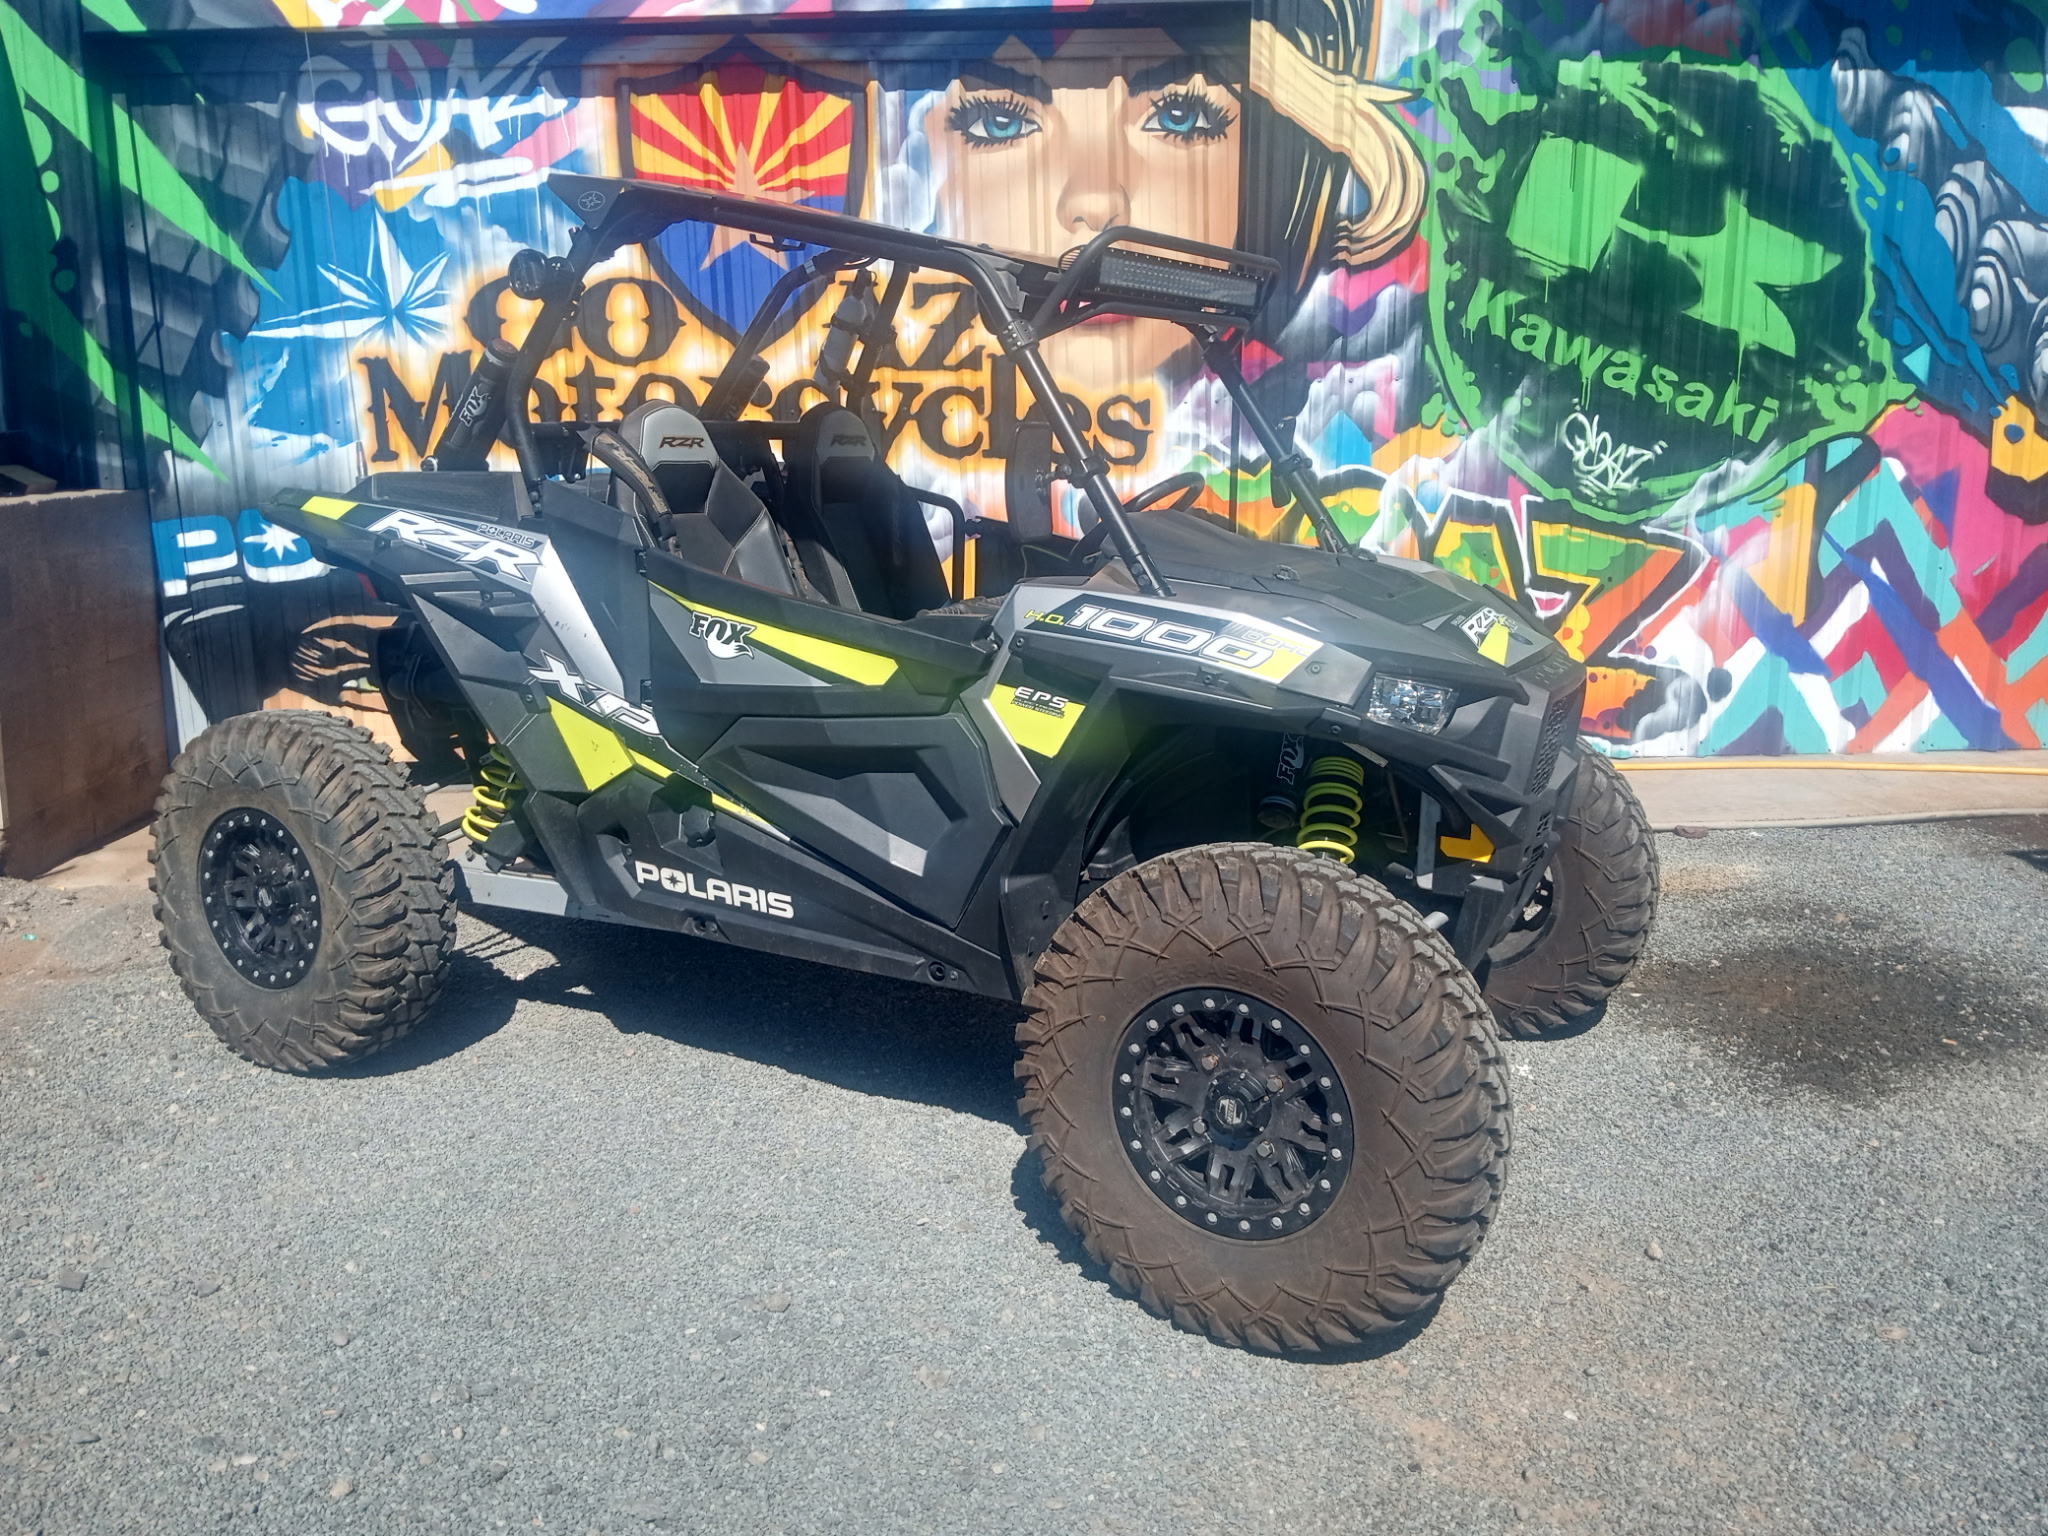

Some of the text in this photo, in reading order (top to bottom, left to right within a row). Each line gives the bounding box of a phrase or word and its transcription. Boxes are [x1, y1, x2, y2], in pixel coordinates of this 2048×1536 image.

[1460, 277, 1779, 444] Kawasaki
[659, 435, 705, 450] RZR
[366, 509, 544, 586] RZR
[476, 522, 536, 548] POLARIS
[689, 611, 757, 647] FOX
[1065, 603, 1275, 669] 1000
[1014, 685, 1069, 710] EPS
[1277, 732, 1301, 785] FOX
[634, 860, 795, 919] POLARIS
